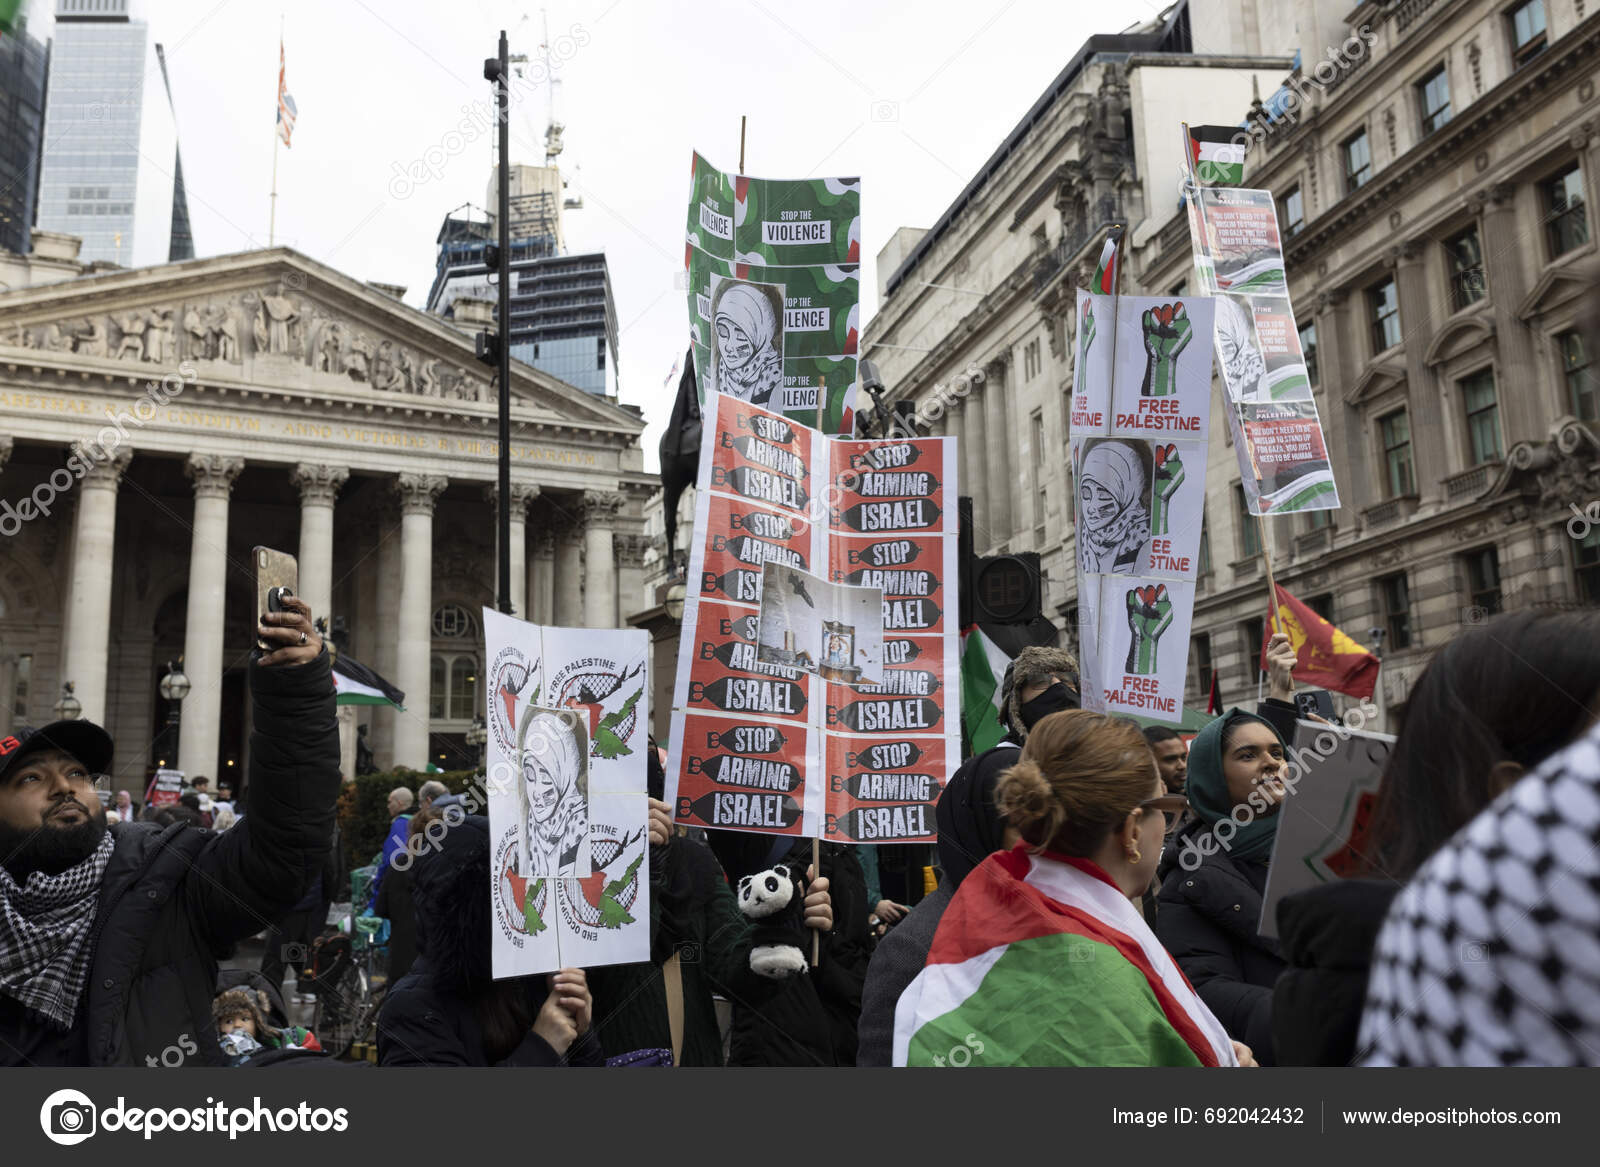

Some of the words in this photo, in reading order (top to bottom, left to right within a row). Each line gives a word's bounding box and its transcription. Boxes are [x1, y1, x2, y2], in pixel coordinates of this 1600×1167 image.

[780, 211, 798, 220] STOP
[800, 210, 812, 220] THE
[766, 223, 826, 242] VIOLENCE
[799, 297, 812, 306] THE
[798, 376, 810, 386] THE
[1138, 399, 1180, 414] FREE
[757, 416, 788, 441] STOP
[1116, 414, 1200, 431] PALESTINE
[746, 436, 801, 477] ARMING
[874, 444, 911, 469] STOP
[744, 467, 801, 510] ISRAEL
[860, 473, 928, 496] ARMING
[754, 514, 786, 538] STOP
[861, 501, 928, 530] ISRAEL
[872, 540, 910, 566] STOP
[861, 570, 928, 596] ARMING
[551, 671, 566, 692] FREE
[564, 658, 616, 674] PALESTINE
[1122, 676, 1160, 694] FREE
[725, 678, 795, 714] ISRAEL
[1104, 689, 1176, 713] PALESTINE
[858, 699, 928, 731] ISRAEL
[734, 726, 776, 752] STOP
[872, 742, 911, 770] STOP
[717, 756, 792, 792] ARMING
[858, 774, 930, 800] ARMING
[713, 792, 787, 828] ISRAEL
[858, 806, 930, 838] ISRAEL
[582, 930, 598, 942] END
